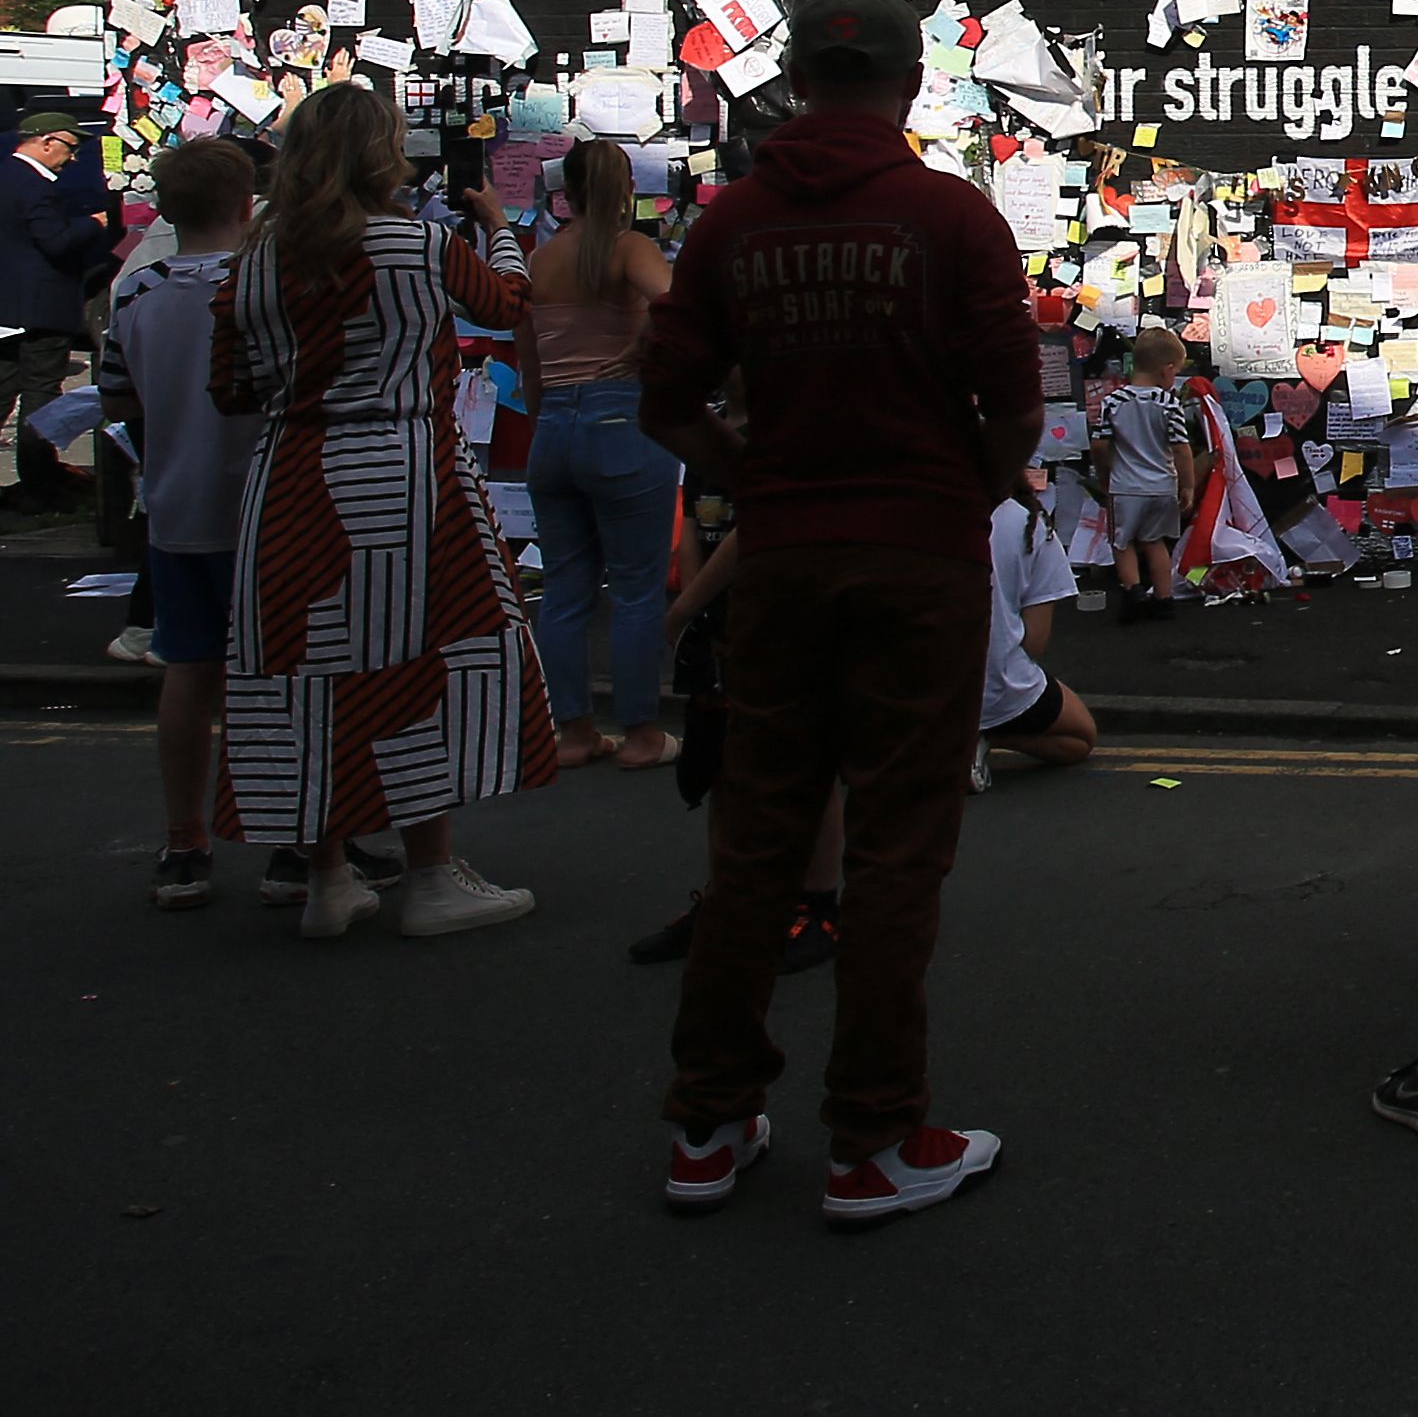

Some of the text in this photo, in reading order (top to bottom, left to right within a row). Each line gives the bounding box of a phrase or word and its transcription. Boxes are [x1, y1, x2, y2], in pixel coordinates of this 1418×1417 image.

[1163, 45, 1408, 140] struggle
[1281, 227, 1329, 238] LOVE
[1285, 252, 1325, 262] HATE
[1294, 241, 1326, 253] NOT
[732, 241, 911, 299] SALTROCK
[782, 289, 857, 326] SURF
